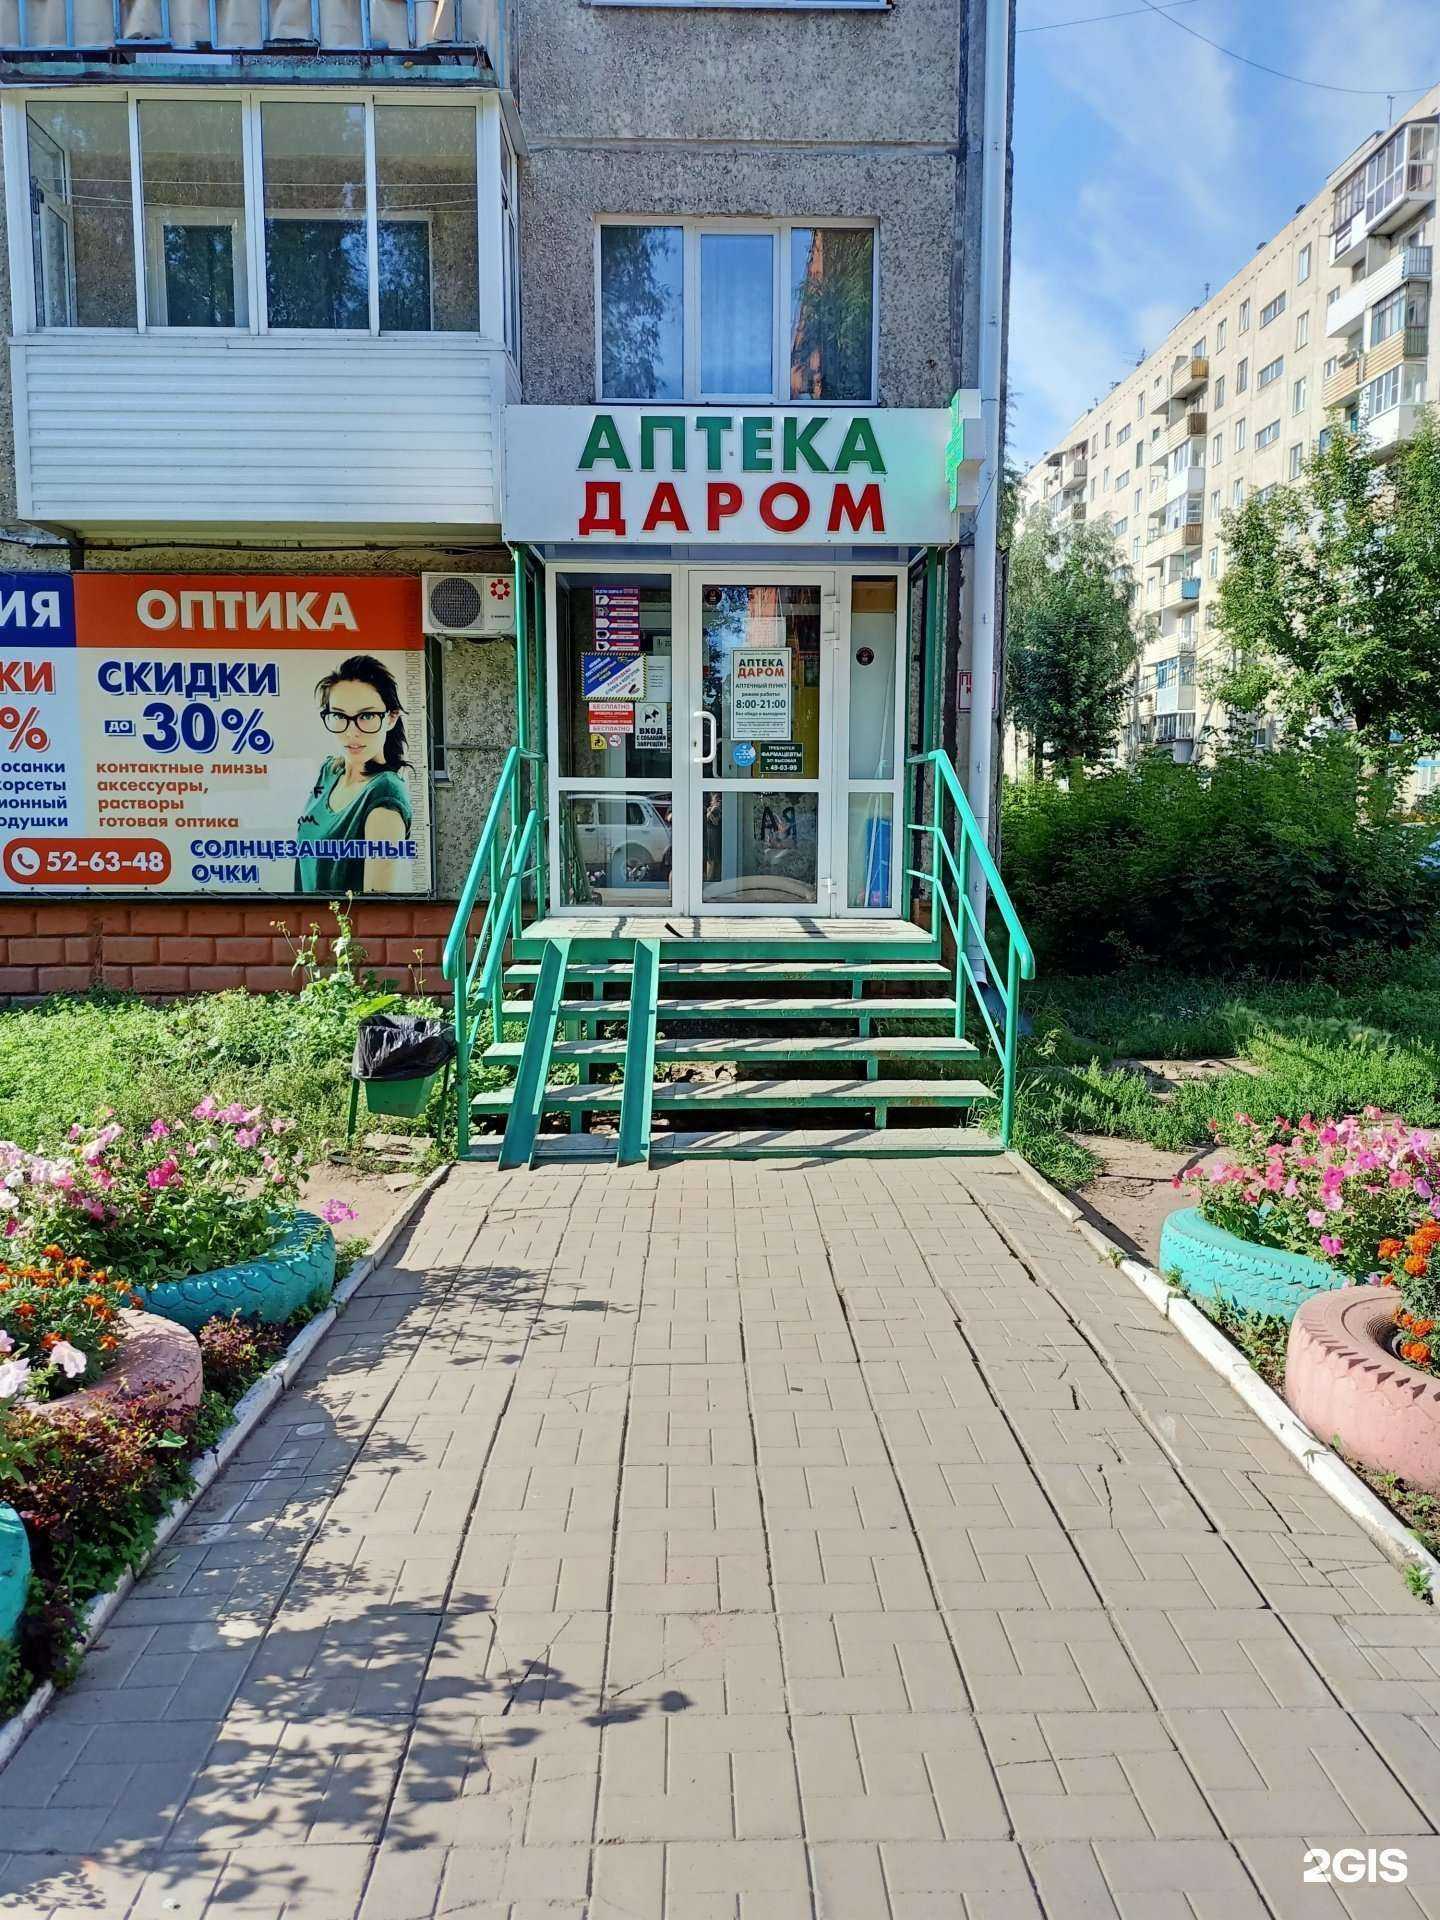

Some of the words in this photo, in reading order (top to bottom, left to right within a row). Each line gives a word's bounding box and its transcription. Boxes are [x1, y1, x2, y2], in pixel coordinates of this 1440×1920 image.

[576, 414, 887, 473] АПТЕКА
[578, 481, 886, 536] ДАРОМ
[136, 589, 360, 632] ОПТИКА
[739, 659, 784, 667] АПТЕКА
[738, 668, 785, 678] ДАРОМ
[97, 660, 279, 701] СКИДКИ
[736, 700, 786, 709] 8:00-21:00
[1, 762, 66, 773] осанки
[96, 761, 204, 774] контактные
[210, 763, 269, 775] линзы
[97, 780, 209, 795] аксессуары,
[98, 798, 184, 812] растворы
[0, 816, 69, 830] одушки
[99, 817, 168, 828] готовая
[175, 816, 240, 829] оптика
[189, 839, 418, 861] СОЛНЦЕЗАЩИТНЫЕ
[47, 851, 165, 872] 52-63-48
[191, 864, 260, 884] ОЧКИ
